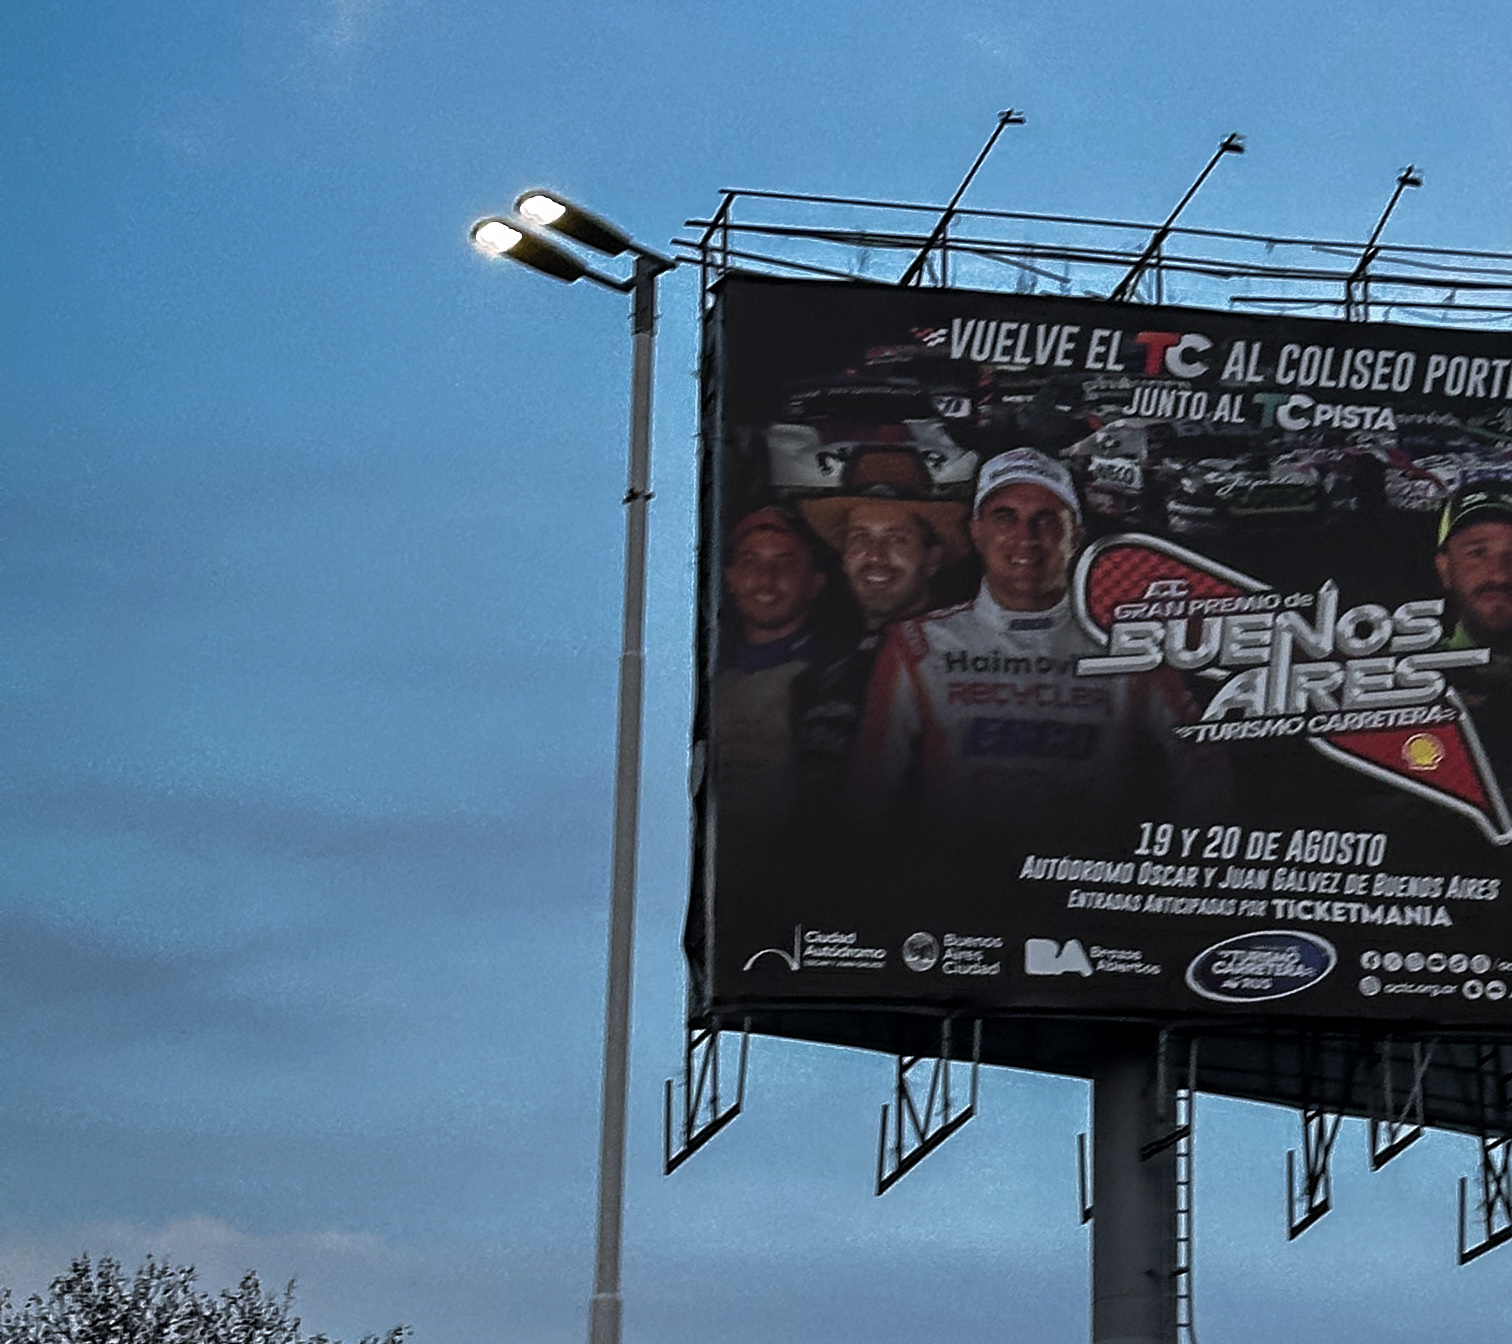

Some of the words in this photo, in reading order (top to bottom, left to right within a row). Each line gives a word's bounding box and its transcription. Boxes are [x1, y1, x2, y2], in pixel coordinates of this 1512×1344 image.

[950, 318, 1080, 367] VUELVE
[1085, 328, 1126, 371] EL
[1135, 331, 1213, 378] TC
[1221, 340, 1265, 383] AL
[1275, 343, 1417, 393] COLISEO
[1121, 386, 1208, 420] JUNTO
[1211, 392, 1246, 424] AL
[1114, 597, 1186, 620] GRAN
[1188, 593, 1282, 616] PREMIO
[1283, 591, 1315, 609] de
[1076, 577, 1445, 676] BUENOS
[1200, 647, 1491, 722] AIRES
[1195, 715, 1305, 743] TURISMO
[1307, 704, 1441, 735] CARRETERA
[1134, 821, 1175, 856] 19
[1180, 828, 1200, 858] Y
[1202, 825, 1242, 859] 20
[1245, 831, 1282, 861] DE
[1283, 829, 1388, 867] AGOSTO
[1203, 866, 1219, 889] Y
[1218, 864, 1270, 890] JUAN
[1343, 873, 1371, 896] DE
[1371, 872, 1445, 899] BUENOS
[1444, 874, 1501, 901] AIRES
[1270, 897, 1453, 927] TICKETMANIA
[1024, 938, 1094, 977] BA
